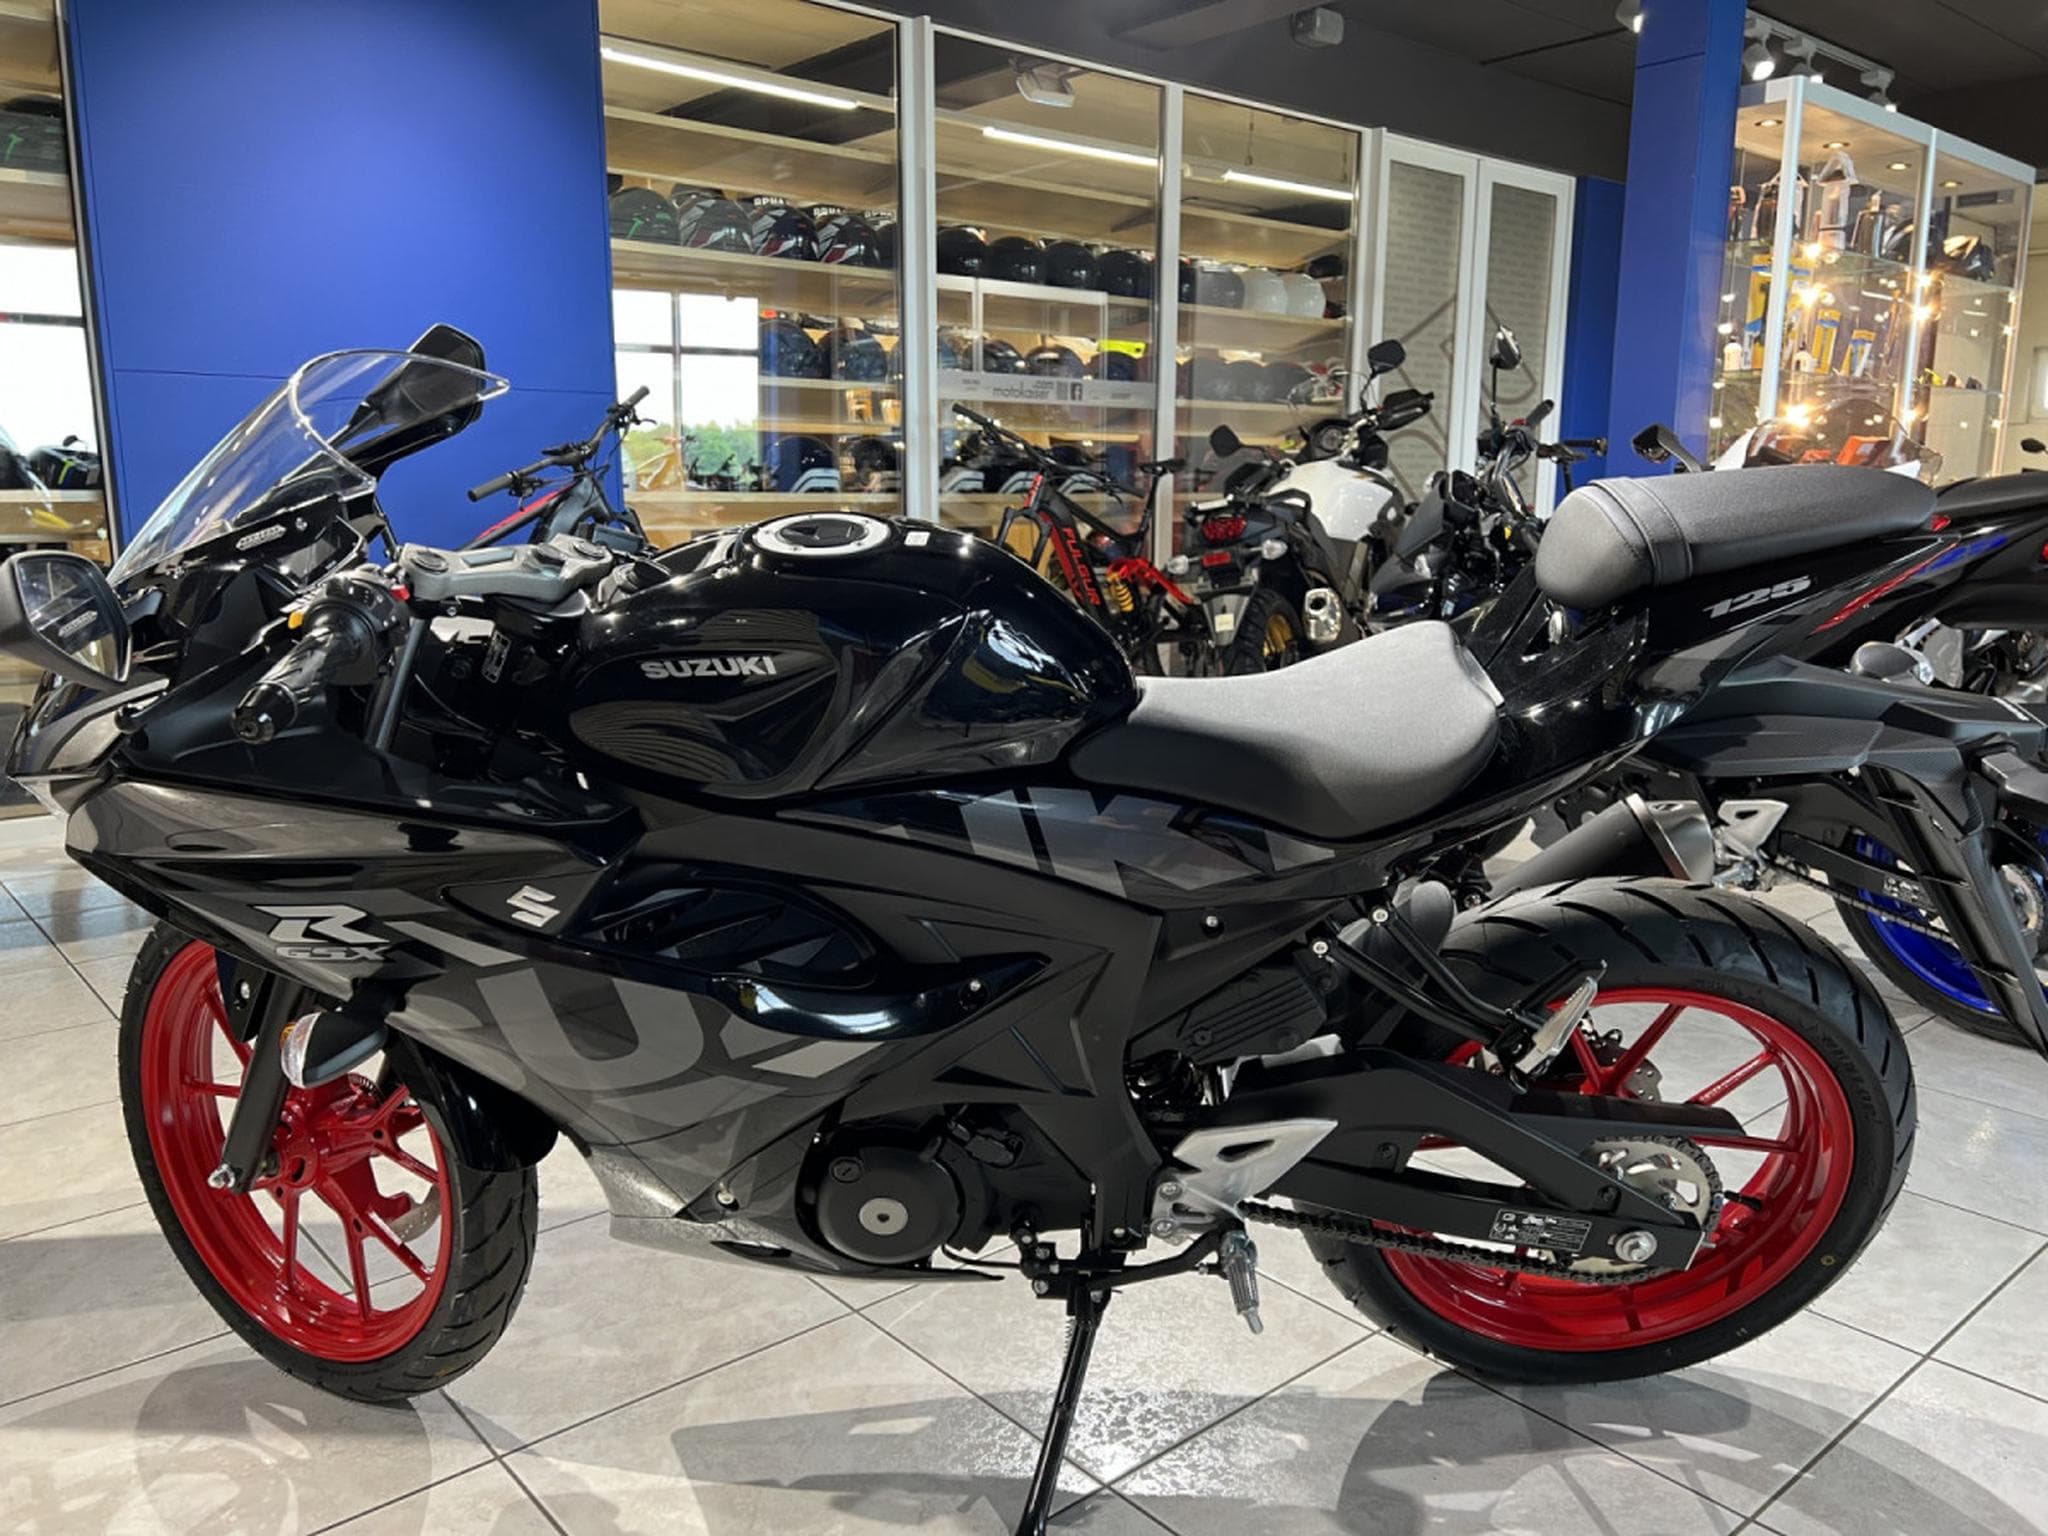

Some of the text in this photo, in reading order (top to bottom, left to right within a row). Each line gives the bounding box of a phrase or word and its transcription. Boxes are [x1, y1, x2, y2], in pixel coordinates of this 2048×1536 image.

[1702, 574, 1812, 619] 125
[640, 655, 777, 680] SUZUKI
[251, 904, 391, 944] R
[275, 945, 390, 962] GSX
